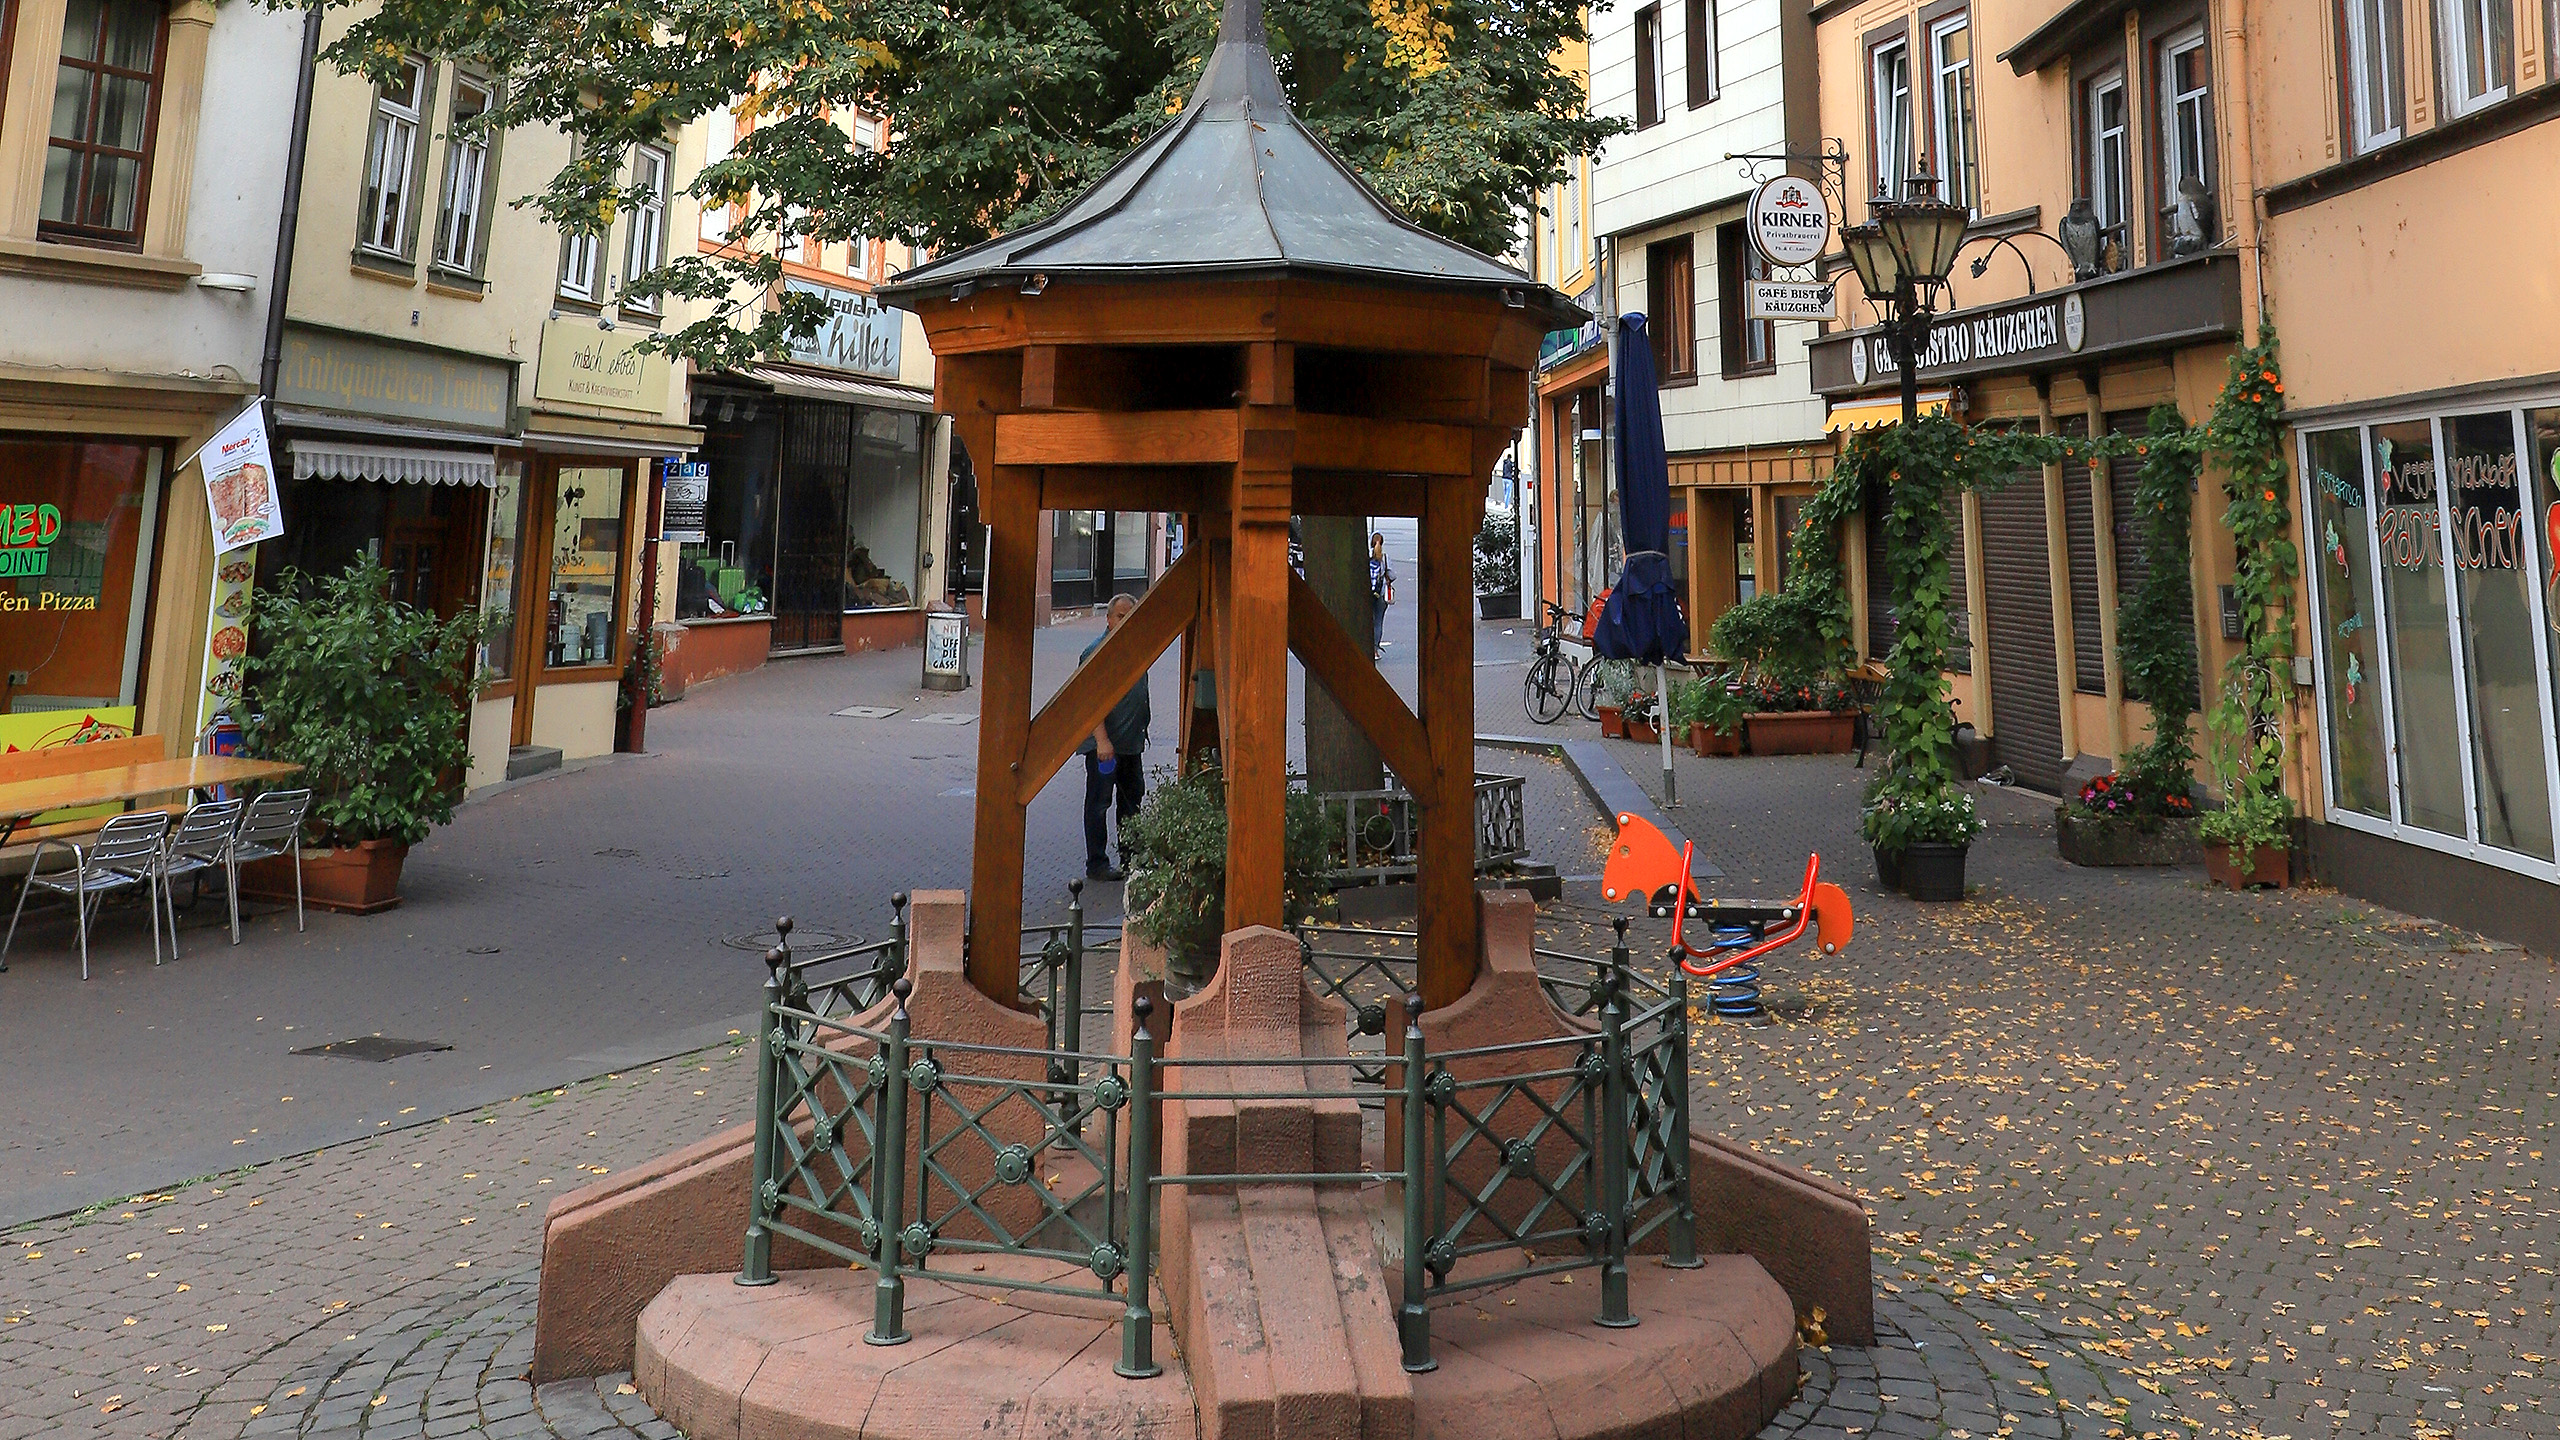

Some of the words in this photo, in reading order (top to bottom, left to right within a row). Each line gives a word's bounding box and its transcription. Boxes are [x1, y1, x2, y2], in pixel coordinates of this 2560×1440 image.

[1762, 212, 1824, 228] KIRNER
[1766, 231, 1820, 240] Privatbrauerei
[38, 591, 95, 611] Pizza
[943, 639, 958, 648] UFF
[943, 650, 957, 658] DIE
[933, 660, 957, 670] GASS!
